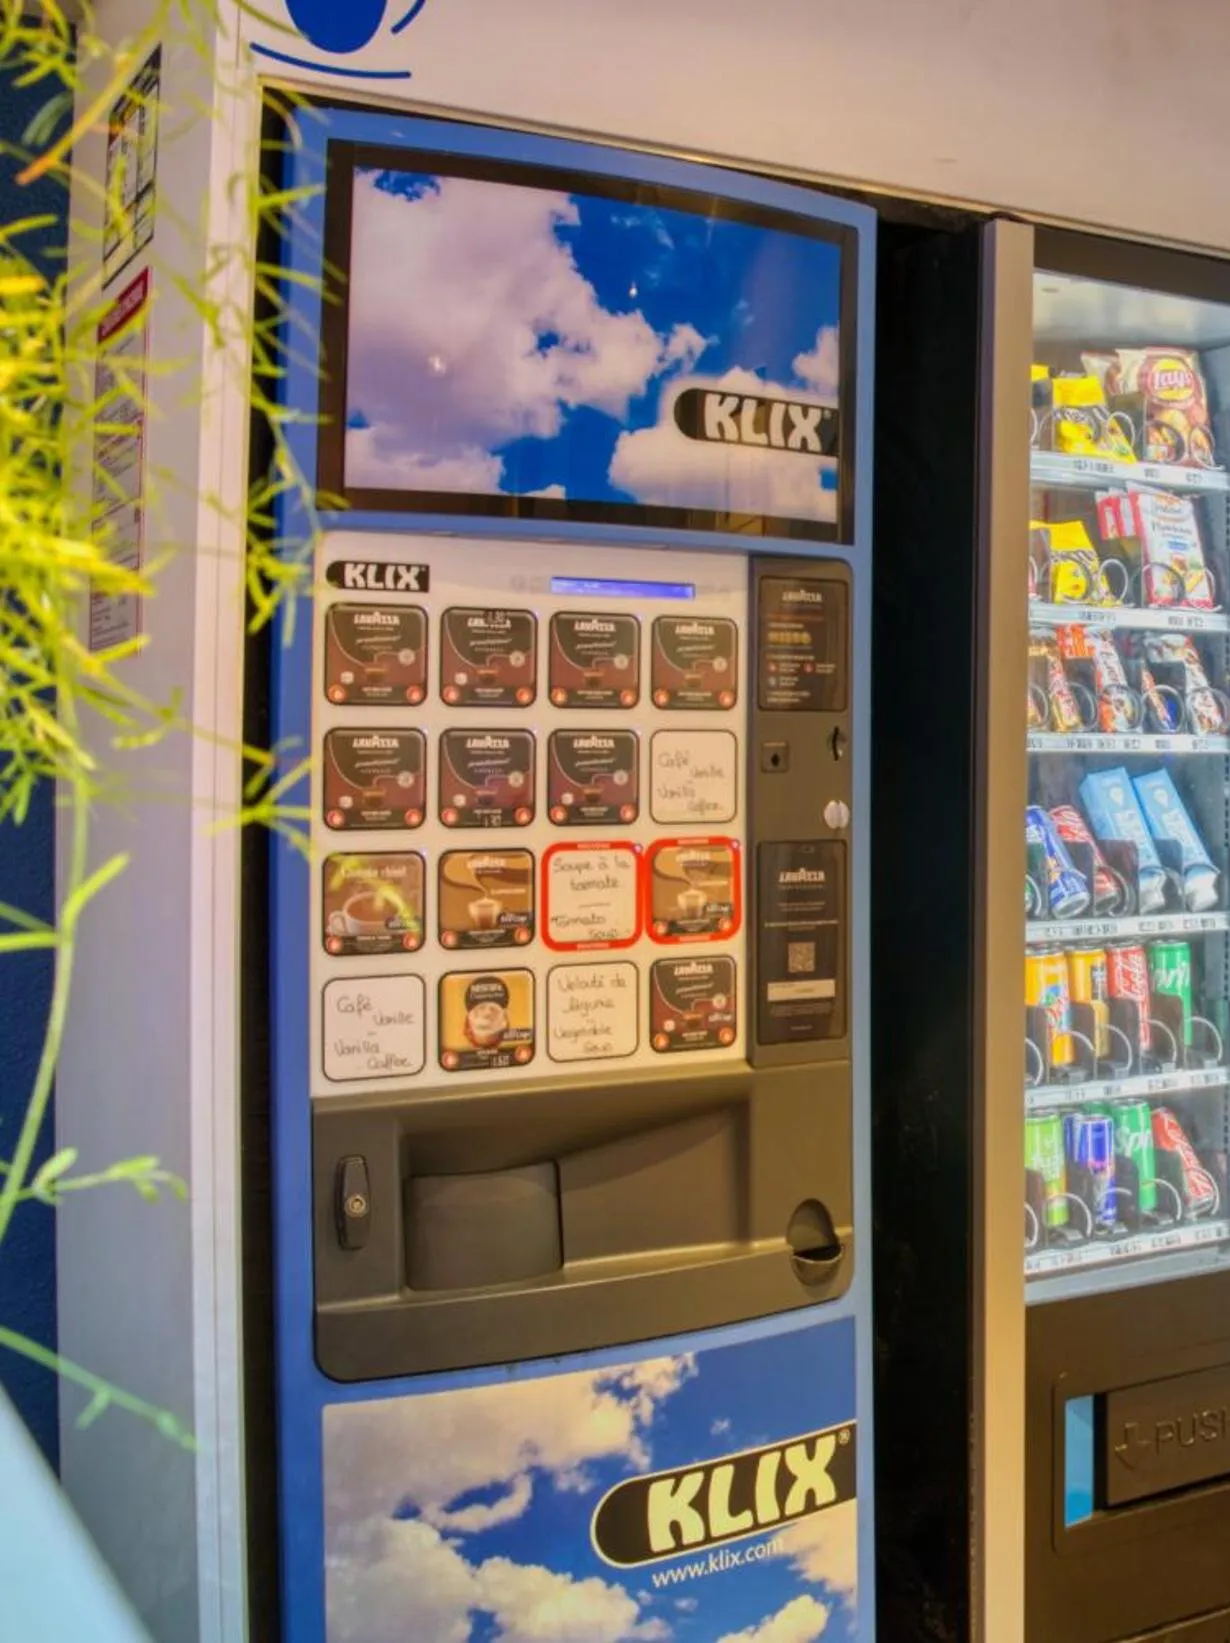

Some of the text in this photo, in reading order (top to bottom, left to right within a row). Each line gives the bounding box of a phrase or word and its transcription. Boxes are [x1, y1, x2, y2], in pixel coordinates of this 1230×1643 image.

[704, 392, 823, 453] KLIX
[344, 562, 421, 592] KLIX
[647, 1433, 837, 1553] KLIX
[652, 1535, 785, 1589] www.klix.com
